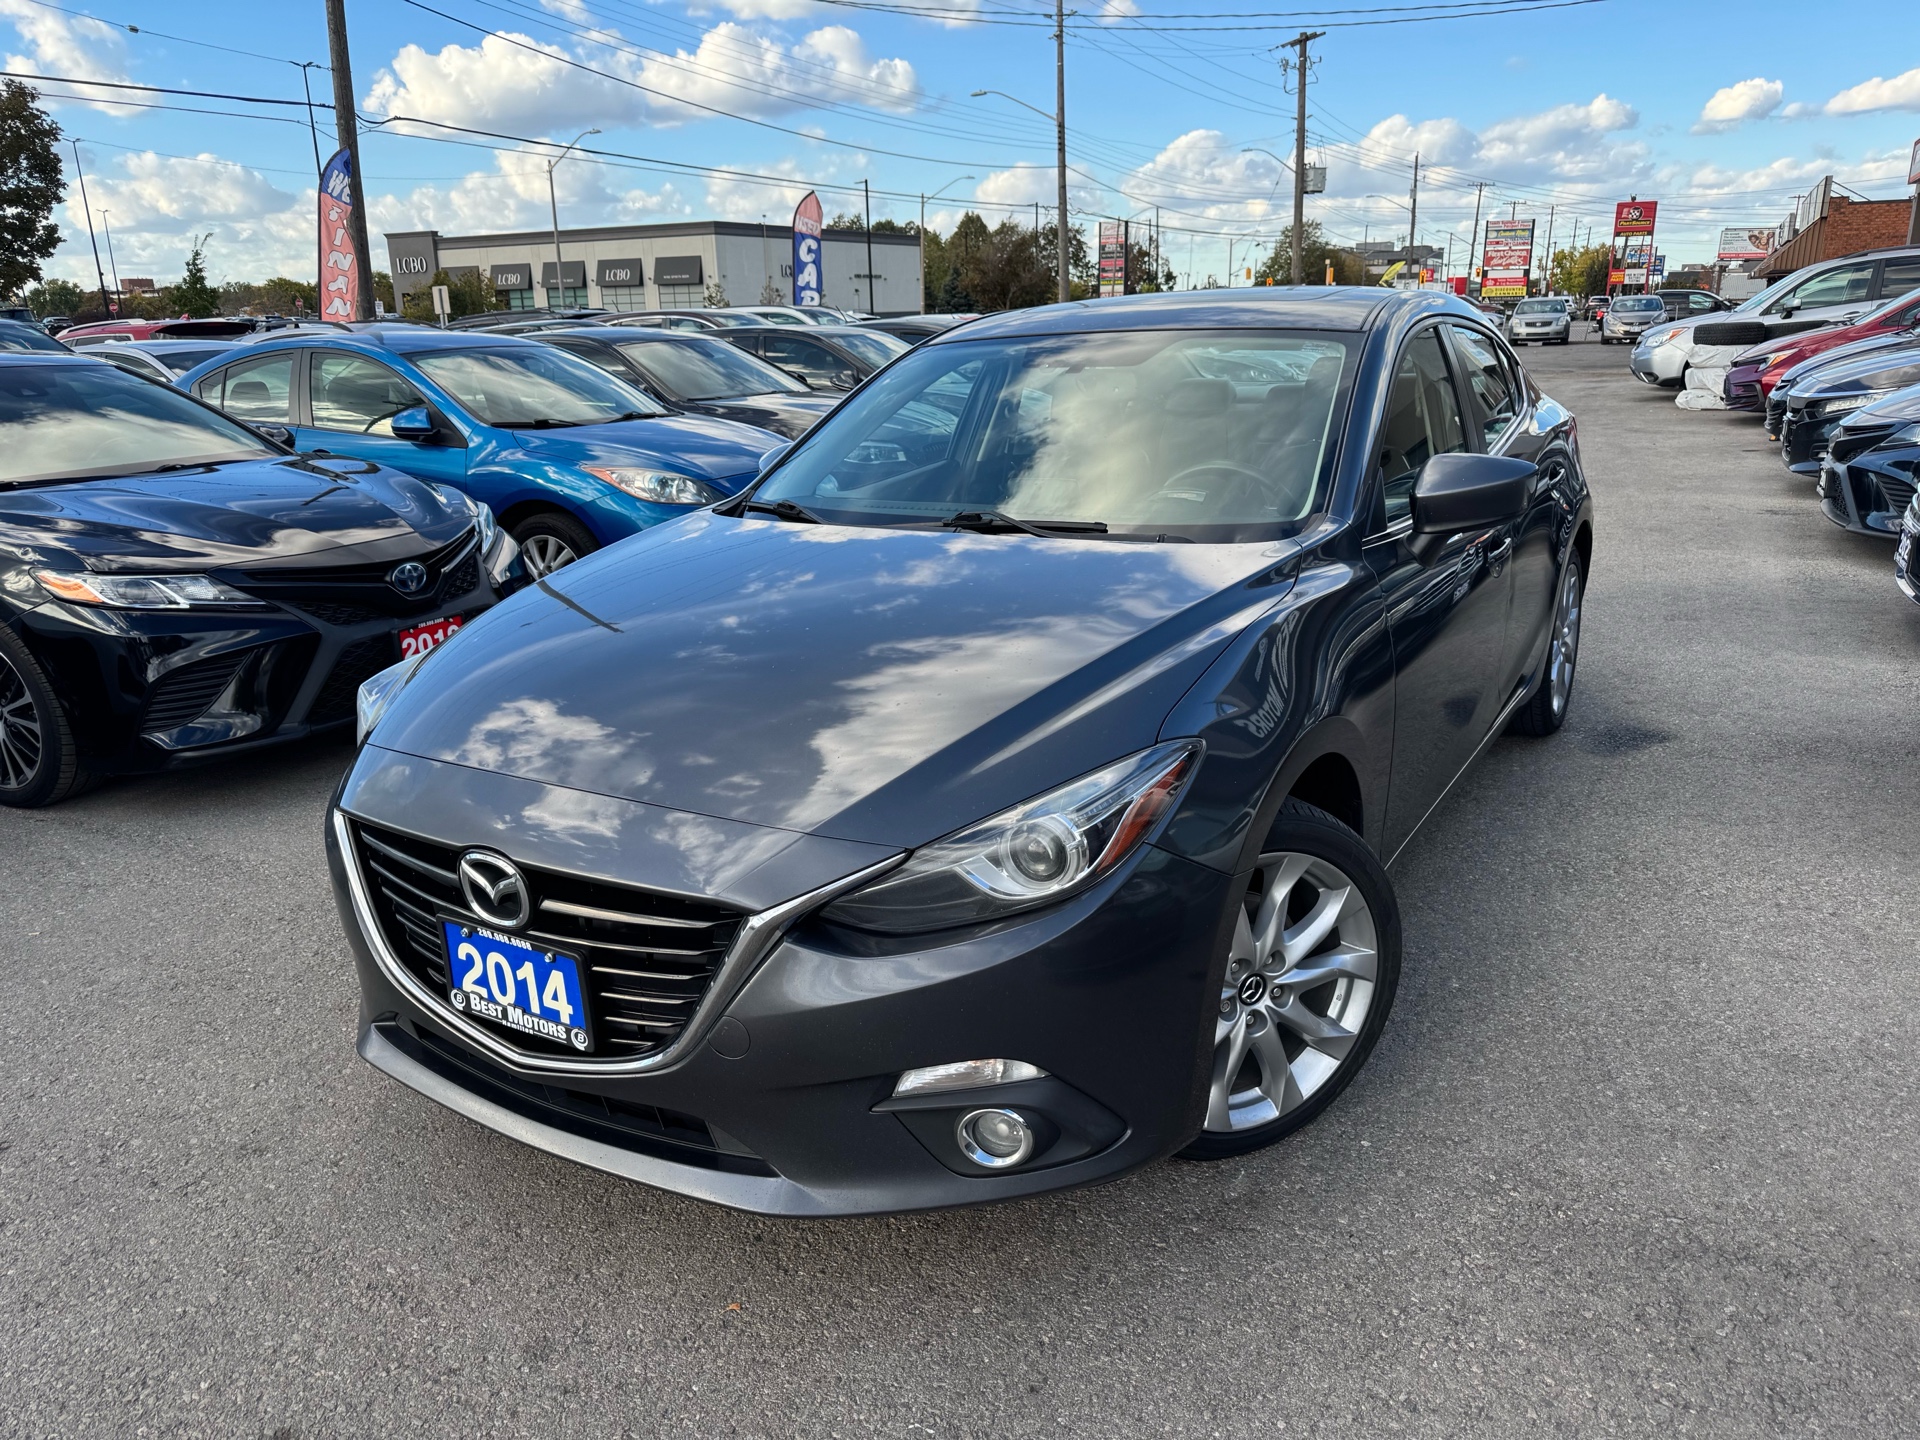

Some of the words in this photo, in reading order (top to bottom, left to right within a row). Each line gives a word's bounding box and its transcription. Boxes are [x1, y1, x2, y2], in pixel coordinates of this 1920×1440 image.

[795, 215, 820, 235] USED
[396, 256, 427, 274] LCBO
[497, 273, 520, 285] LCBO
[605, 268, 631, 281] LCBO
[457, 942, 573, 1025] 2014
